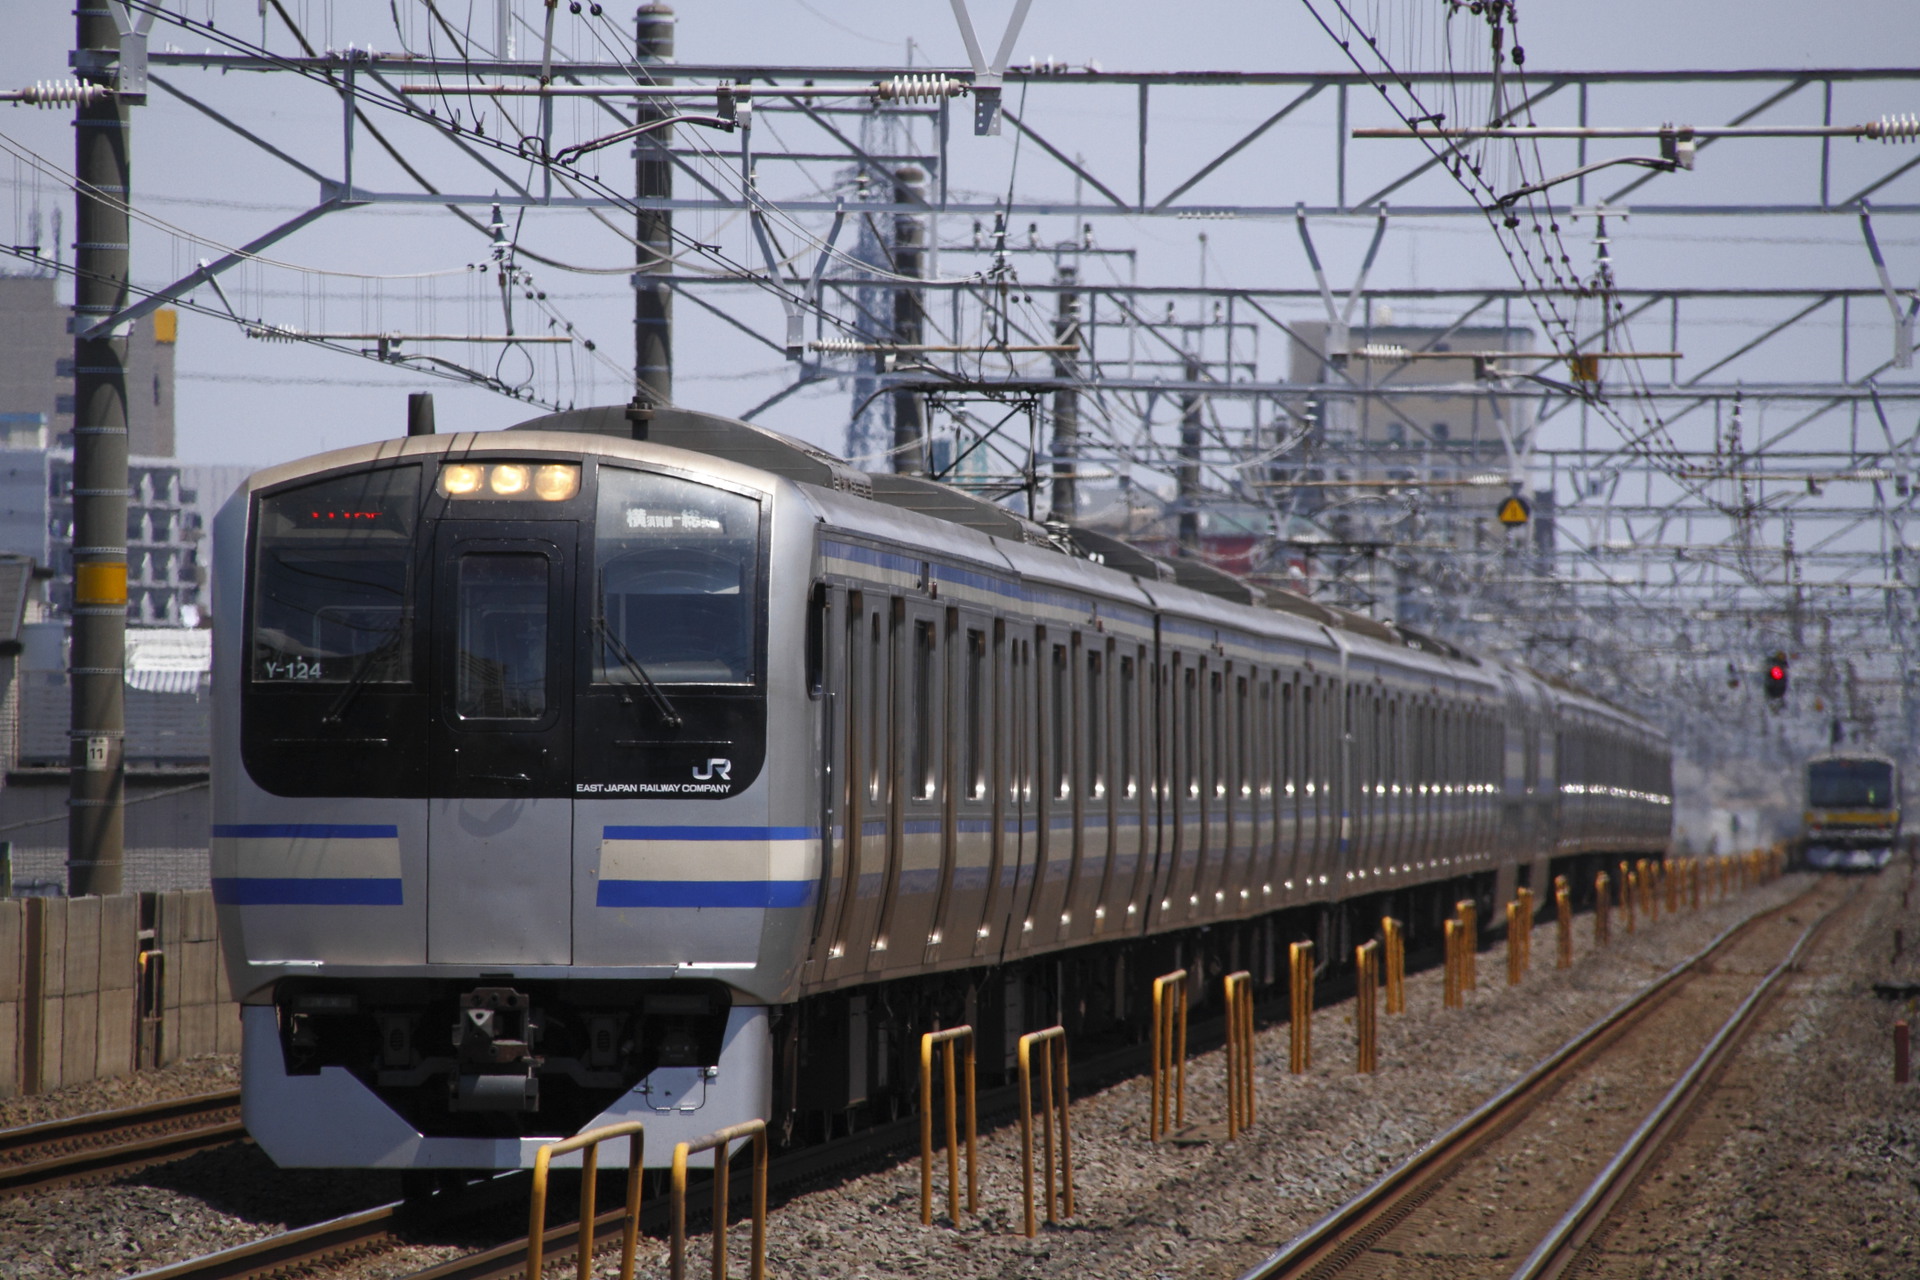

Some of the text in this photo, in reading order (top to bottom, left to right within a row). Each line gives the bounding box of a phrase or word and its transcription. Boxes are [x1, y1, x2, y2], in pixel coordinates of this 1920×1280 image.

[265, 662, 322, 679] Y-124
[90, 748, 103, 760] 11
[692, 758, 732, 781] JR
[576, 783, 731, 793] EAST JAPAN RAILWAY COMPANY
